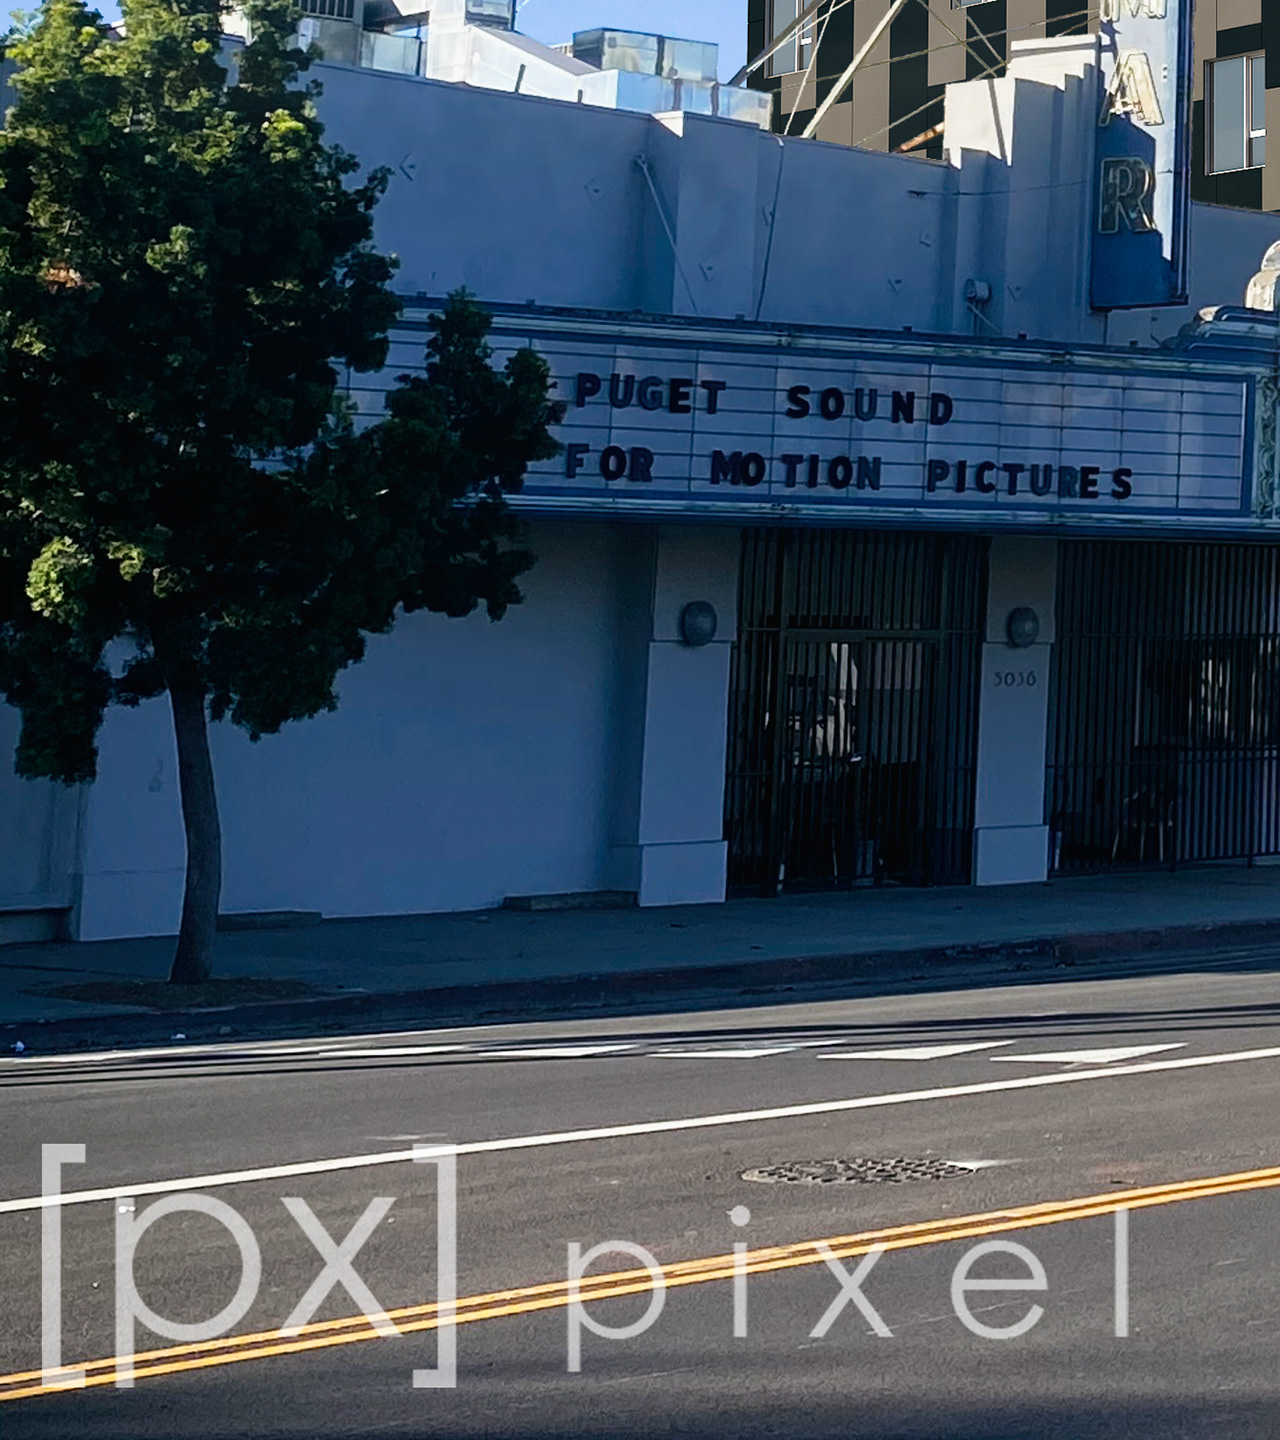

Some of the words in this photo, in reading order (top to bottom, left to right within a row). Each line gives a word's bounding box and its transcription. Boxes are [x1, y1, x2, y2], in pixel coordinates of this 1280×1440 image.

[574, 372, 727, 415] PUGET
[785, 385, 954, 425] SOUND
[565, 442, 655, 483] FOR
[709, 449, 882, 491] MOTION
[926, 459, 1133, 500] PICTURES
